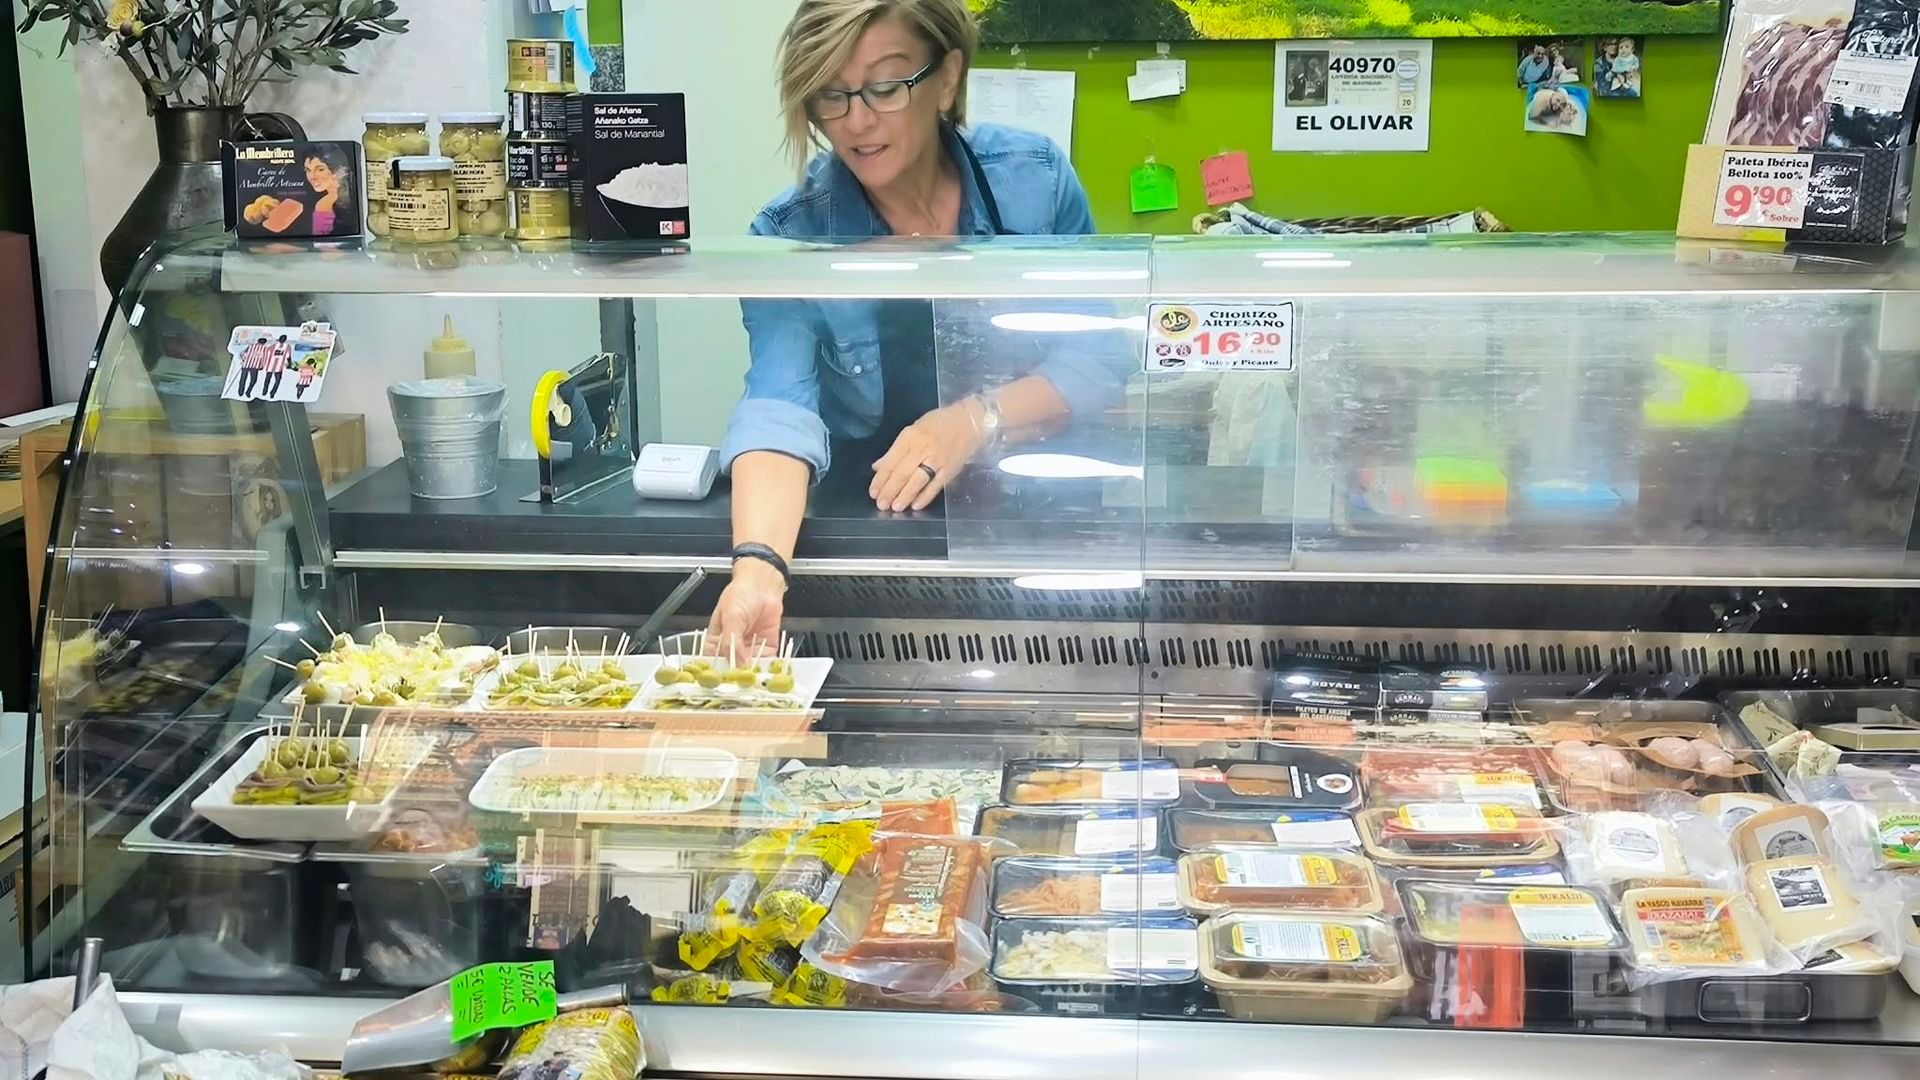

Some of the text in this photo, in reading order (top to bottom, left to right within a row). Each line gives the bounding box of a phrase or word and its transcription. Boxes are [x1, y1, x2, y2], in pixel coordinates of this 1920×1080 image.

[1329, 57, 1396, 73] 40970
[1296, 115, 1413, 130] EL OLIVAR
[594, 129, 665, 139] Sal de Manantial
[1728, 157, 1809, 168] Paleta Ibérica
[1728, 169, 1803, 180] Bellota 100%
[1770, 214, 1799, 222] Sobre
[1209, 311, 1278, 319] CHORIZO
[1202, 320, 1285, 328] ARTESANO
[499, 965, 511, 975] 2
[538, 971, 556, 988] SE
